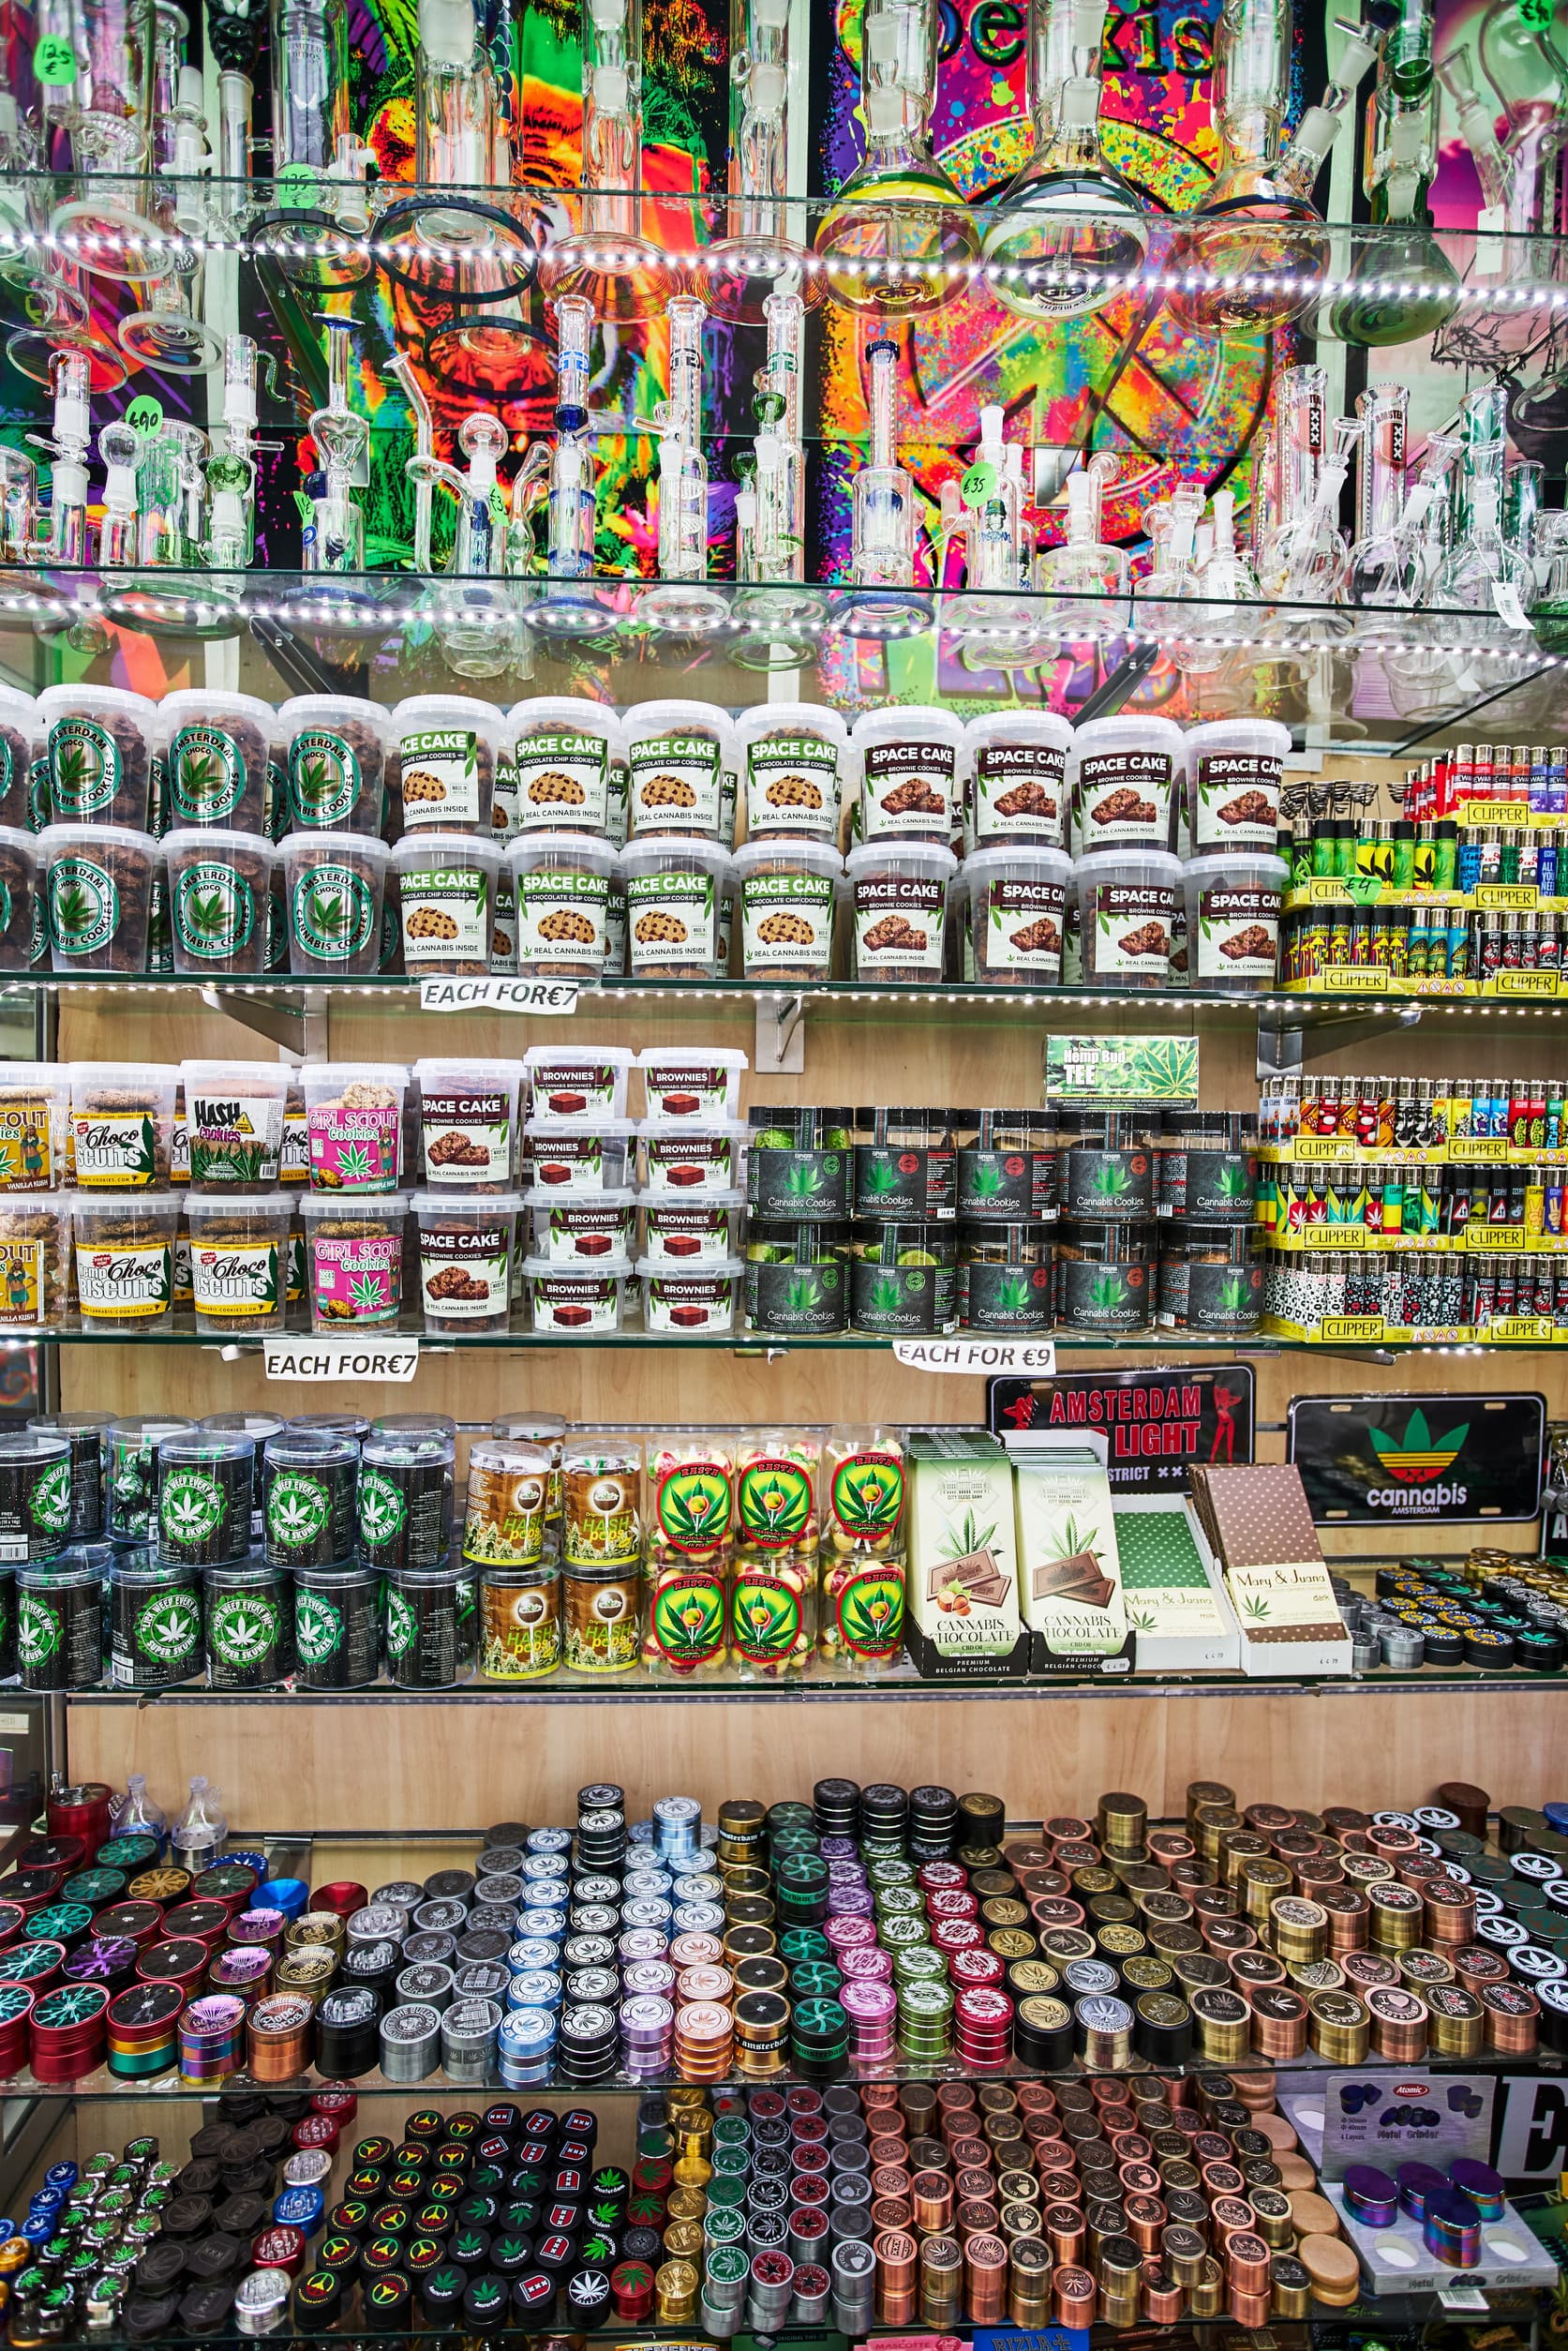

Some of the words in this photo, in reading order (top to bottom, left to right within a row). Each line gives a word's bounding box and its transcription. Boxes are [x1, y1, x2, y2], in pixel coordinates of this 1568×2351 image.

[173, 733, 234, 759] AMSTERDAM
[422, 734, 467, 750] CAKE
[517, 740, 557, 756] SPACE
[561, 738, 603, 755] CAKE
[186, 746, 212, 756] CHOCO
[631, 741, 670, 759] SPACE
[673, 741, 715, 756] CAKE
[752, 742, 799, 758] SPACE
[803, 744, 836, 761] CAKE
[873, 747, 918, 763] SPACE
[921, 748, 953, 764] CAKE
[522, 757, 552, 766] CHOCOLATE
[986, 751, 1034, 765] SPACE
[1037, 752, 1065, 768] CAKE
[1084, 757, 1127, 775] SPACE
[1129, 757, 1167, 771] CAKE
[1209, 760, 1259, 773] SPACE
[82, 762, 114, 804] COOKIES
[204, 772, 240, 811] COOKIES
[322, 773, 354, 815] COOKIES
[1473, 807, 1522, 820] CLIPPER
[1542, 862, 1553, 871] ALL
[180, 871, 241, 894] AMSTERDAM
[434, 874, 479, 888] CAKE
[663, 876, 707, 891] CAKE
[1542, 872, 1554, 880] YOU
[193, 885, 221, 893] CHOCO
[300, 873, 363, 897] AMSTERDAM
[315, 886, 342, 894] CHOCO
[524, 877, 574, 891] SPACE
[576, 877, 607, 892] CAKE
[745, 881, 790, 895] SPACE
[793, 880, 829, 893] CAKE
[858, 884, 896, 899] SPACE
[900, 884, 937, 898] CAKE
[1003, 885, 1050, 899] SPACE
[1052, 889, 1065, 902] CA
[1110, 891, 1157, 903] SPACE
[1159, 892, 1173, 905] CA
[1211, 894, 1260, 907] SPACE
[1482, 891, 1531, 903] CLIPPER
[81, 900, 112, 944] COOKIES
[178, 909, 215, 950] CANNABIS
[220, 904, 249, 948] COOKIES
[296, 908, 332, 951] CANNABIS
[337, 908, 367, 950] COOKIES
[1330, 973, 1381, 987] CLIPPER
[1501, 975, 1552, 990] CLIPPER
[425, 984, 490, 1003] EACH
[1064, 1049, 1098, 1063] Hemp
[1102, 1050, 1126, 1063] Bud
[543, 1071, 594, 1081] BROWNIES
[656, 1072, 708, 1082] BROWNIES
[1064, 1064, 1095, 1085] TEE
[195, 1101, 240, 1128] HASH
[422, 1101, 455, 1114] SPACE
[458, 1100, 500, 1114] CAKE
[309, 1111, 345, 1130] GIRL
[347, 1110, 397, 1131] SCOUT
[86, 1125, 139, 1149] Choco
[535, 1143, 578, 1153] BROWNIES
[660, 1145, 712, 1153] BROWNIES
[1300, 1143, 1349, 1156] CLIPPER
[1454, 1142, 1501, 1156] CLIPPER
[768, 1197, 804, 1207] Cannabis
[806, 1198, 836, 1207] Cookies
[568, 1214, 619, 1223] BROWNIES
[657, 1215, 709, 1223] BROWNIES
[420, 1235, 453, 1248] SPACE
[457, 1235, 500, 1248] CAKE
[1309, 1230, 1359, 1243] CLIPPER
[1471, 1230, 1519, 1244] CLIPPER
[316, 1241, 354, 1261] GIRL
[357, 1241, 402, 1260] SCOUT
[108, 1257, 161, 1280] Choco
[214, 1257, 266, 1280] Choco
[81, 1276, 163, 1298] BISCUITS
[546, 1284, 600, 1294] BROWNIES
[664, 1285, 716, 1295] BROWNIES
[1073, 1308, 1108, 1318] Cannabis
[1109, 1310, 1141, 1319] Cookies
[1327, 1321, 1378, 1336] CLIPPER
[1497, 1321, 1546, 1336] CLIPPER
[267, 1355, 330, 1374] EACH
[902, 1347, 958, 1364] EACH
[967, 1349, 1016, 1366] FOR
[1022, 1349, 1051, 1367] €9
[1050, 1385, 1201, 1423] AMSTERDAM
[1115, 1422, 1201, 1457] LIGHT
[855, 1456, 893, 1466] RASTA
[680, 1467, 719, 1477] RASTA
[757, 1464, 795, 1474] RASTA
[1109, 1465, 1150, 1482] STRICT
[1366, 1483, 1468, 1506] cannabis
[1392, 1506, 1441, 1515] AMSTERDAM
[186, 1519, 211, 1536] SKUNK
[291, 1522, 319, 1539] SKUNK
[583, 1517, 629, 1531] HASH
[674, 1580, 711, 1590] RASTA
[744, 1579, 782, 1589] RASTA
[863, 1574, 897, 1584] RASTA
[1236, 1573, 1272, 1587] Mary
[1275, 1570, 1287, 1584] &
[1289, 1569, 1325, 1583] Juana
[1125, 1595, 1158, 1606] Mary
[1162, 1593, 1174, 1604] &
[1176, 1593, 1213, 1605] Juana
[937, 1619, 1004, 1631] CANNABIS
[1044, 1615, 1112, 1626] CANNABIS
[507, 1625, 553, 1645] HASH
[586, 1623, 631, 1639] HASH
[147, 1640, 170, 1655] SUPER
[172, 1635, 196, 1655] SKUNK
[217, 1640, 239, 1659] SUPER
[243, 1640, 267, 1659] SKUNK
[1396, 2086, 1423, 2094] Atomic
